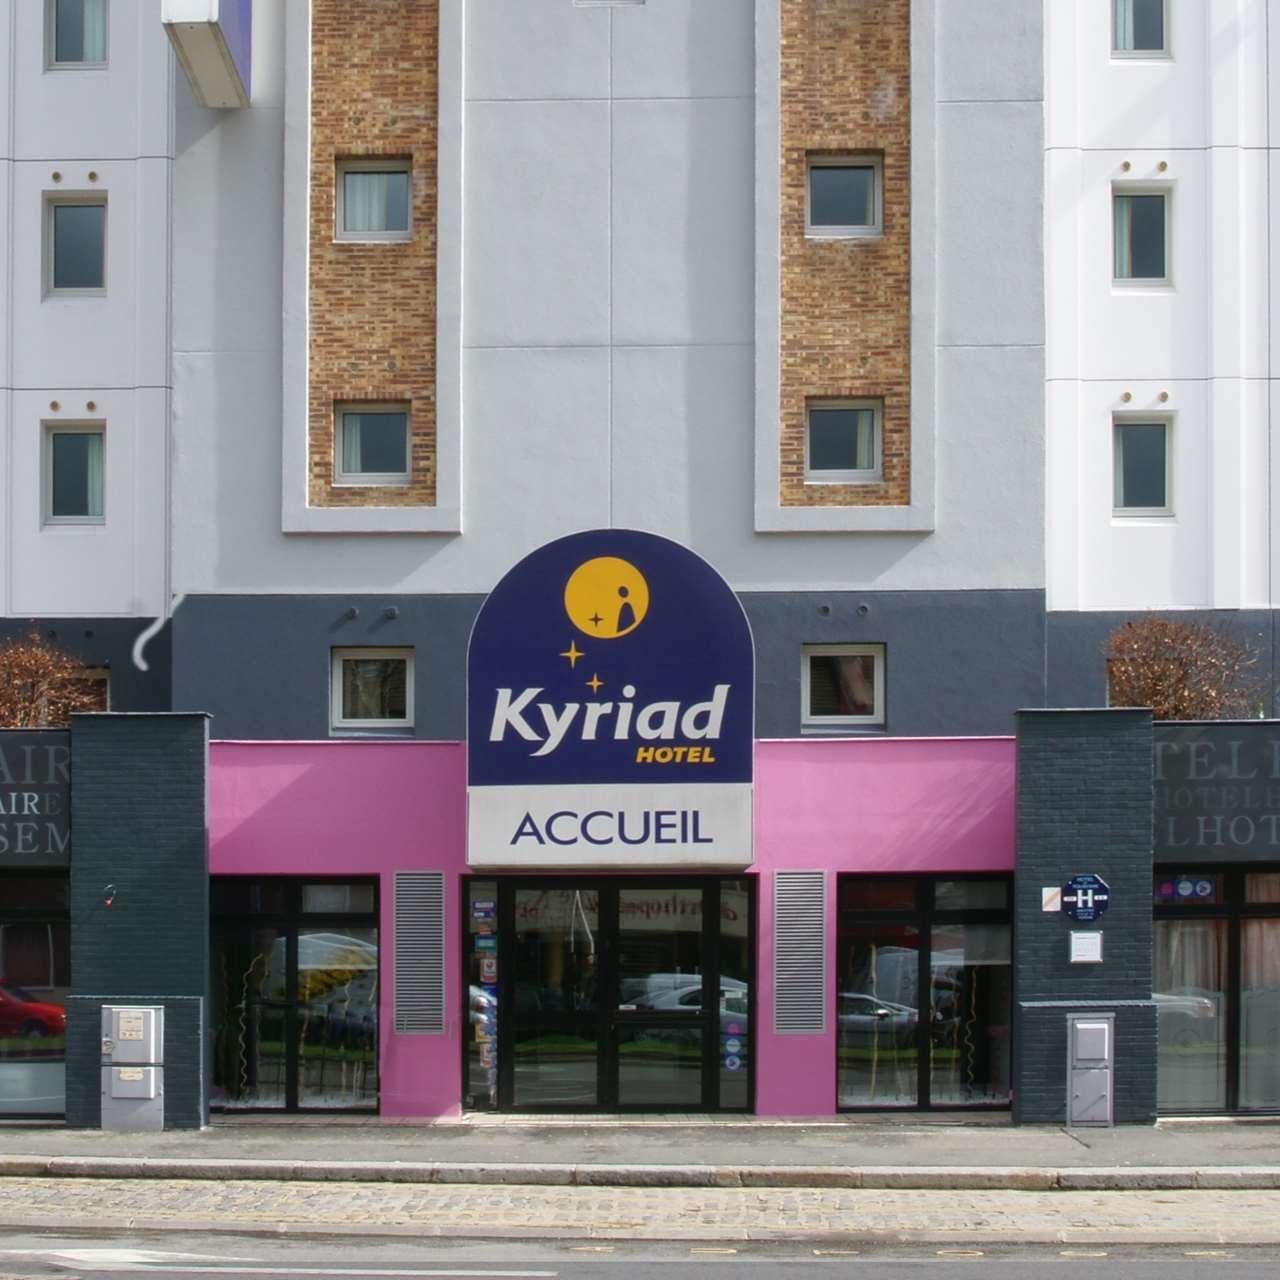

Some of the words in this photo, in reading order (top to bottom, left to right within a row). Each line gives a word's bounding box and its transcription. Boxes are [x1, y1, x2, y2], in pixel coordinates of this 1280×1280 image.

[489, 684, 731, 756] Kyriad
[635, 747, 715, 764] HOTEL
[510, 810, 714, 846] ACCUEIL
[1077, 889, 1093, 908] H
